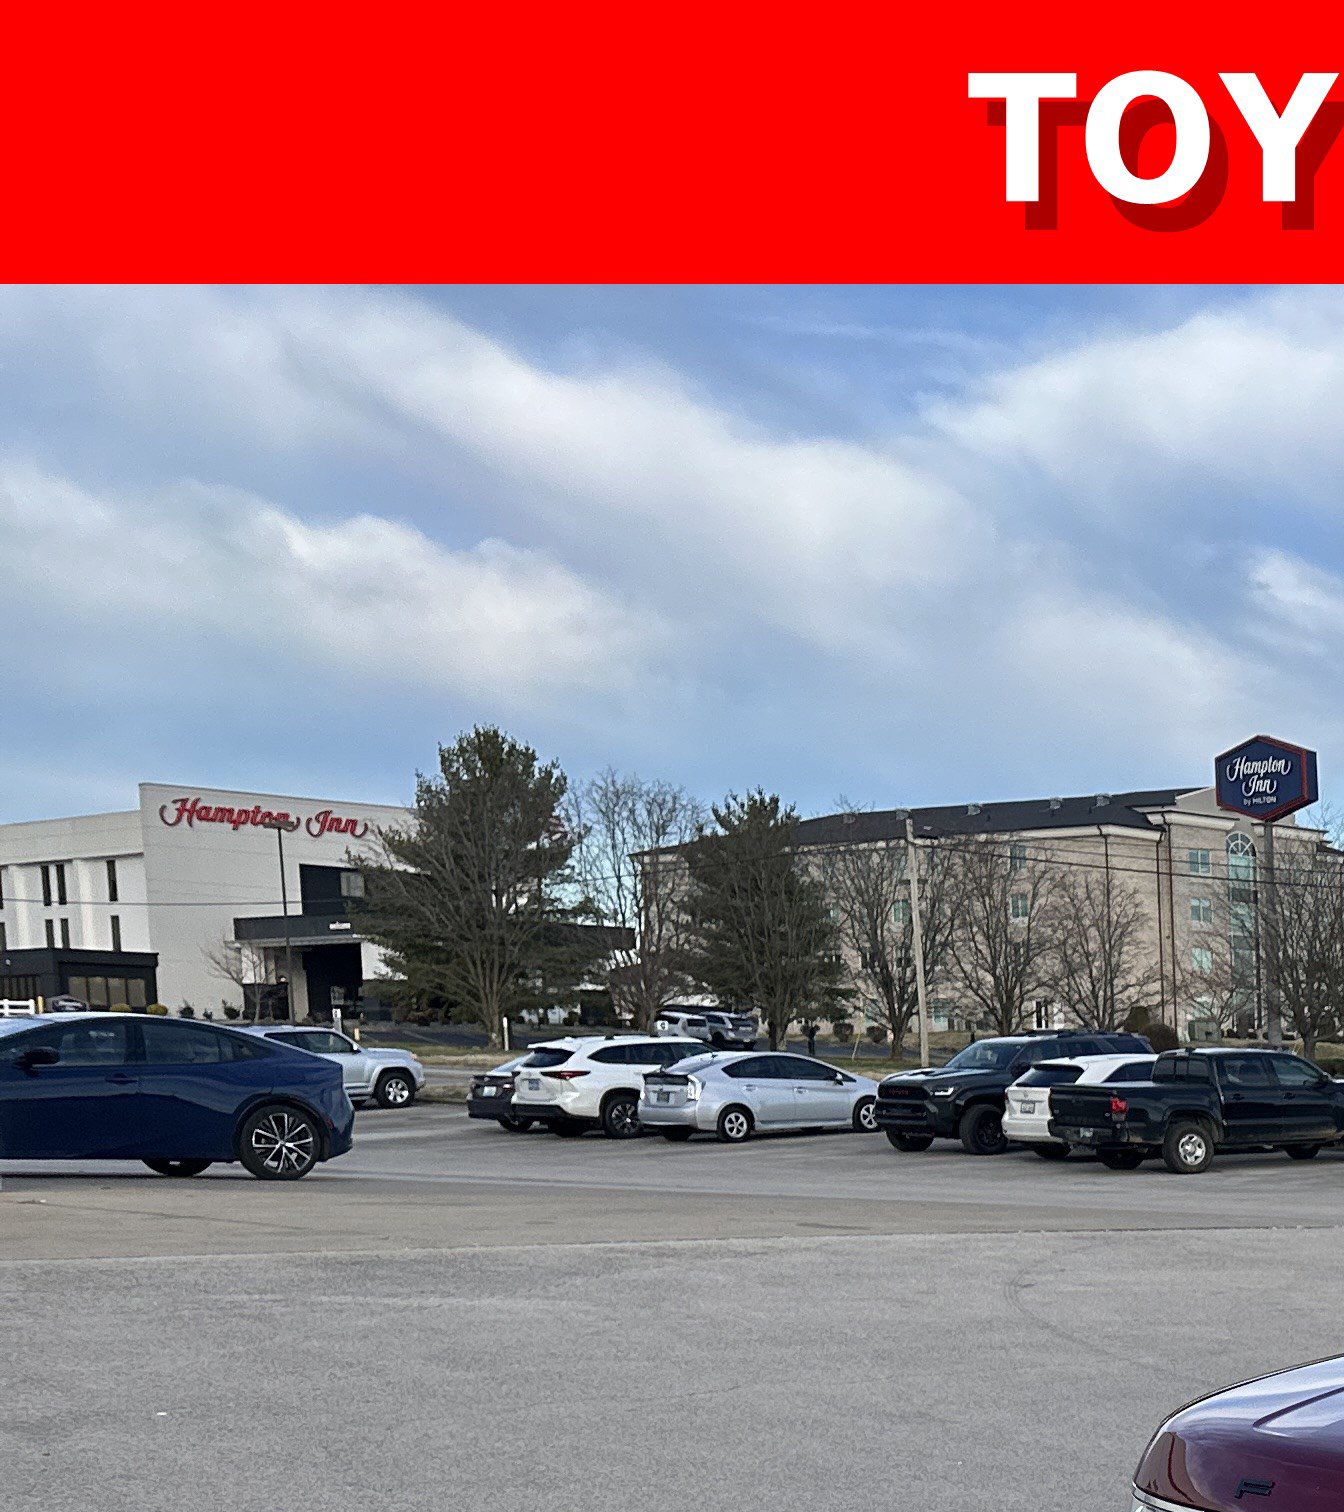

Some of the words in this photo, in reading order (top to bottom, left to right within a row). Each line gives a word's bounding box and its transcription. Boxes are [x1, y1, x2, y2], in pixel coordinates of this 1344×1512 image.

[1226, 756, 1291, 781] Hampton
[1242, 775, 1277, 796] Inn
[1252, 796, 1277, 804] HILTON
[159, 798, 300, 832] Hampton
[306, 810, 369, 838] Inn
